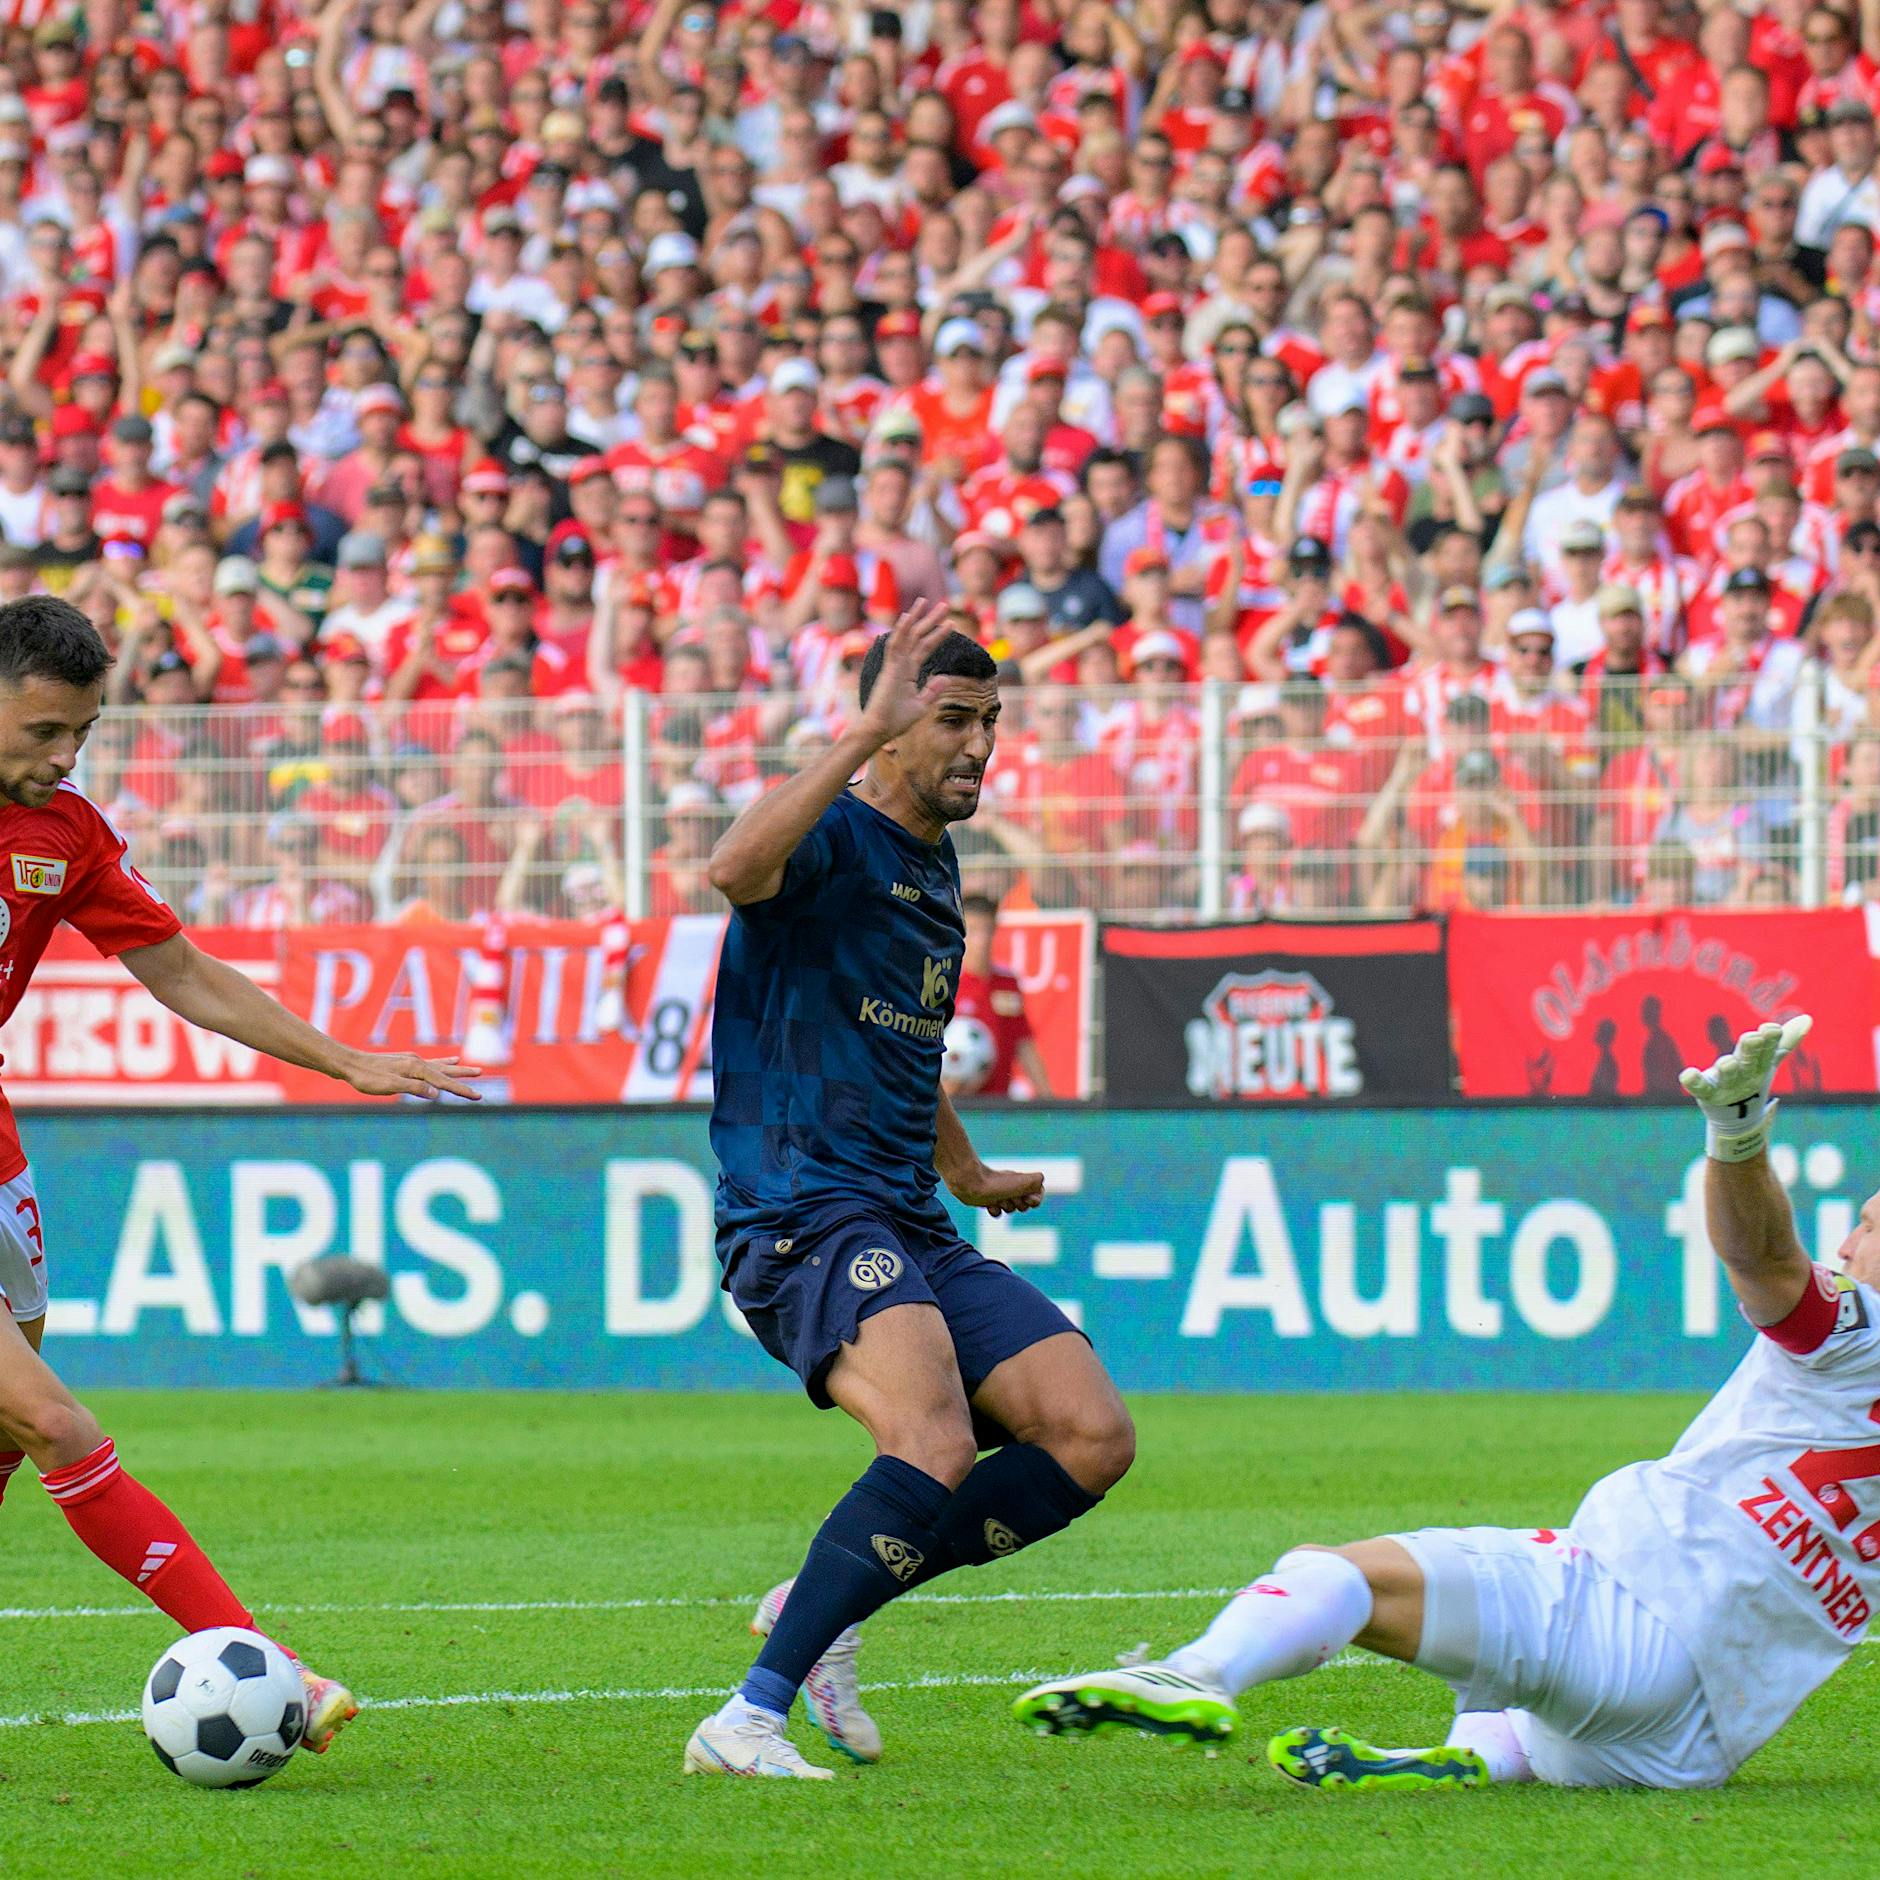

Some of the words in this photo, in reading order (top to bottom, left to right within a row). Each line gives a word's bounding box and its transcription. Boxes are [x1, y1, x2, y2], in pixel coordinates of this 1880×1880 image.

[891, 881, 922, 903] JAKO
[1184, 1017, 1364, 1099] MEUTE
[1738, 1475, 1871, 1638] ZENTNER
